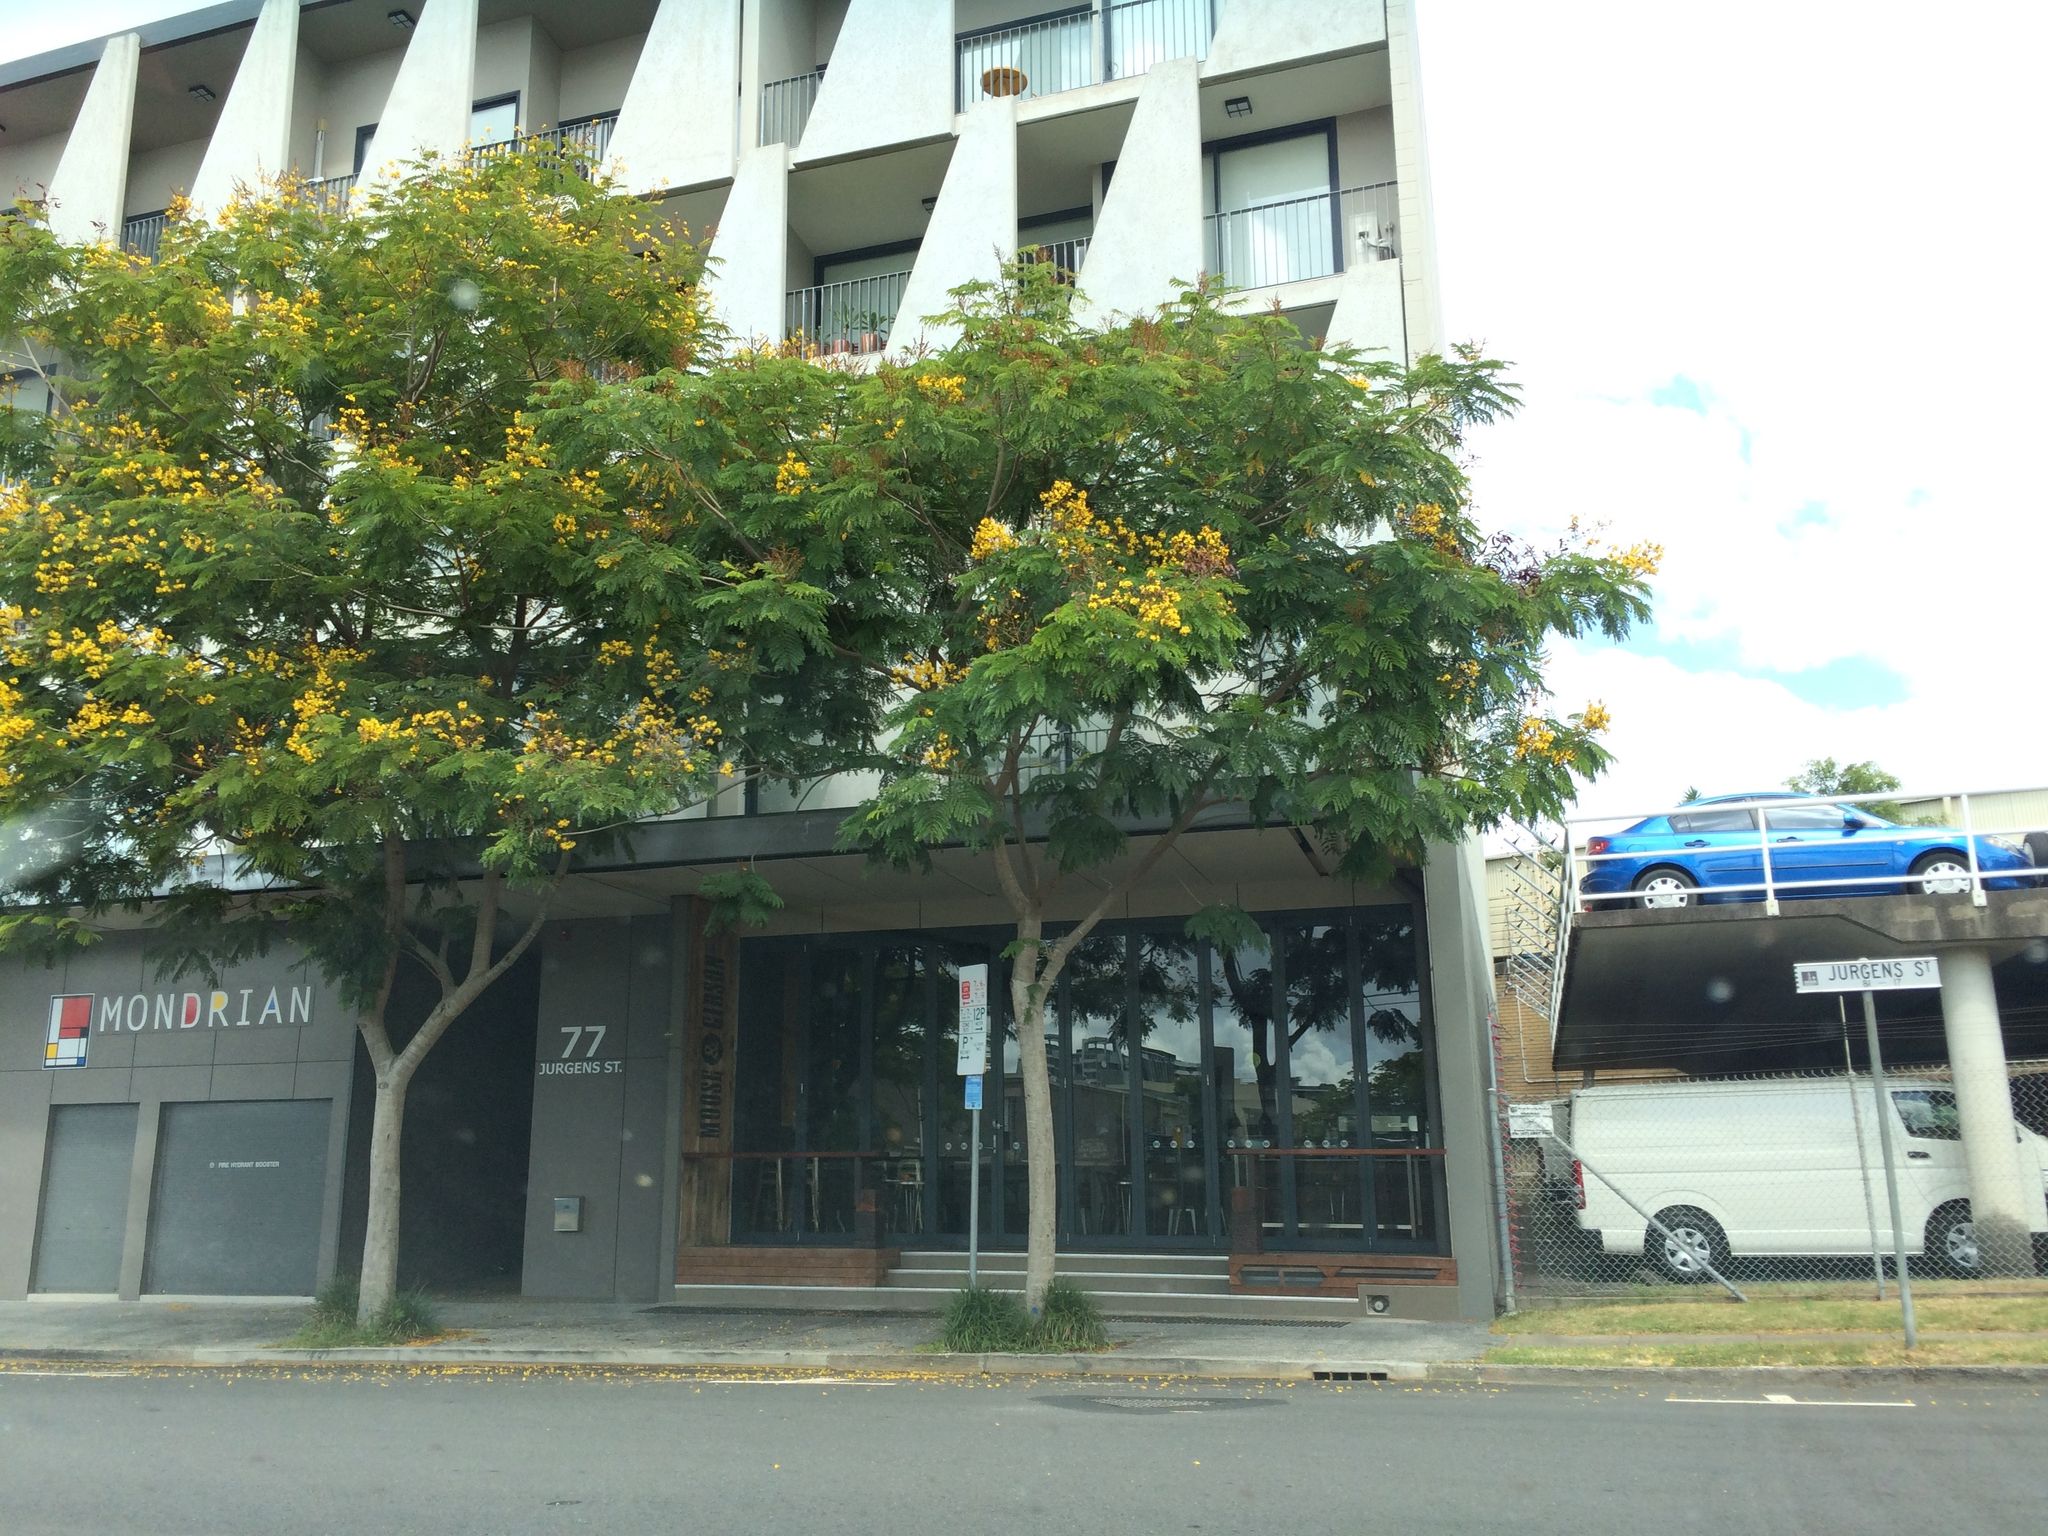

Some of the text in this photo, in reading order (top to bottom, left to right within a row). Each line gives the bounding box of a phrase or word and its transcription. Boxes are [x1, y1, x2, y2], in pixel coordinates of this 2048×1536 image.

[1829, 962, 1903, 981] JURGENS
[100, 986, 311, 1032] MONDRIAN
[561, 1025, 606, 1058] 77
[539, 1061, 622, 1075] JURGENS ST.
[701, 1070, 722, 1137] MOOSE
